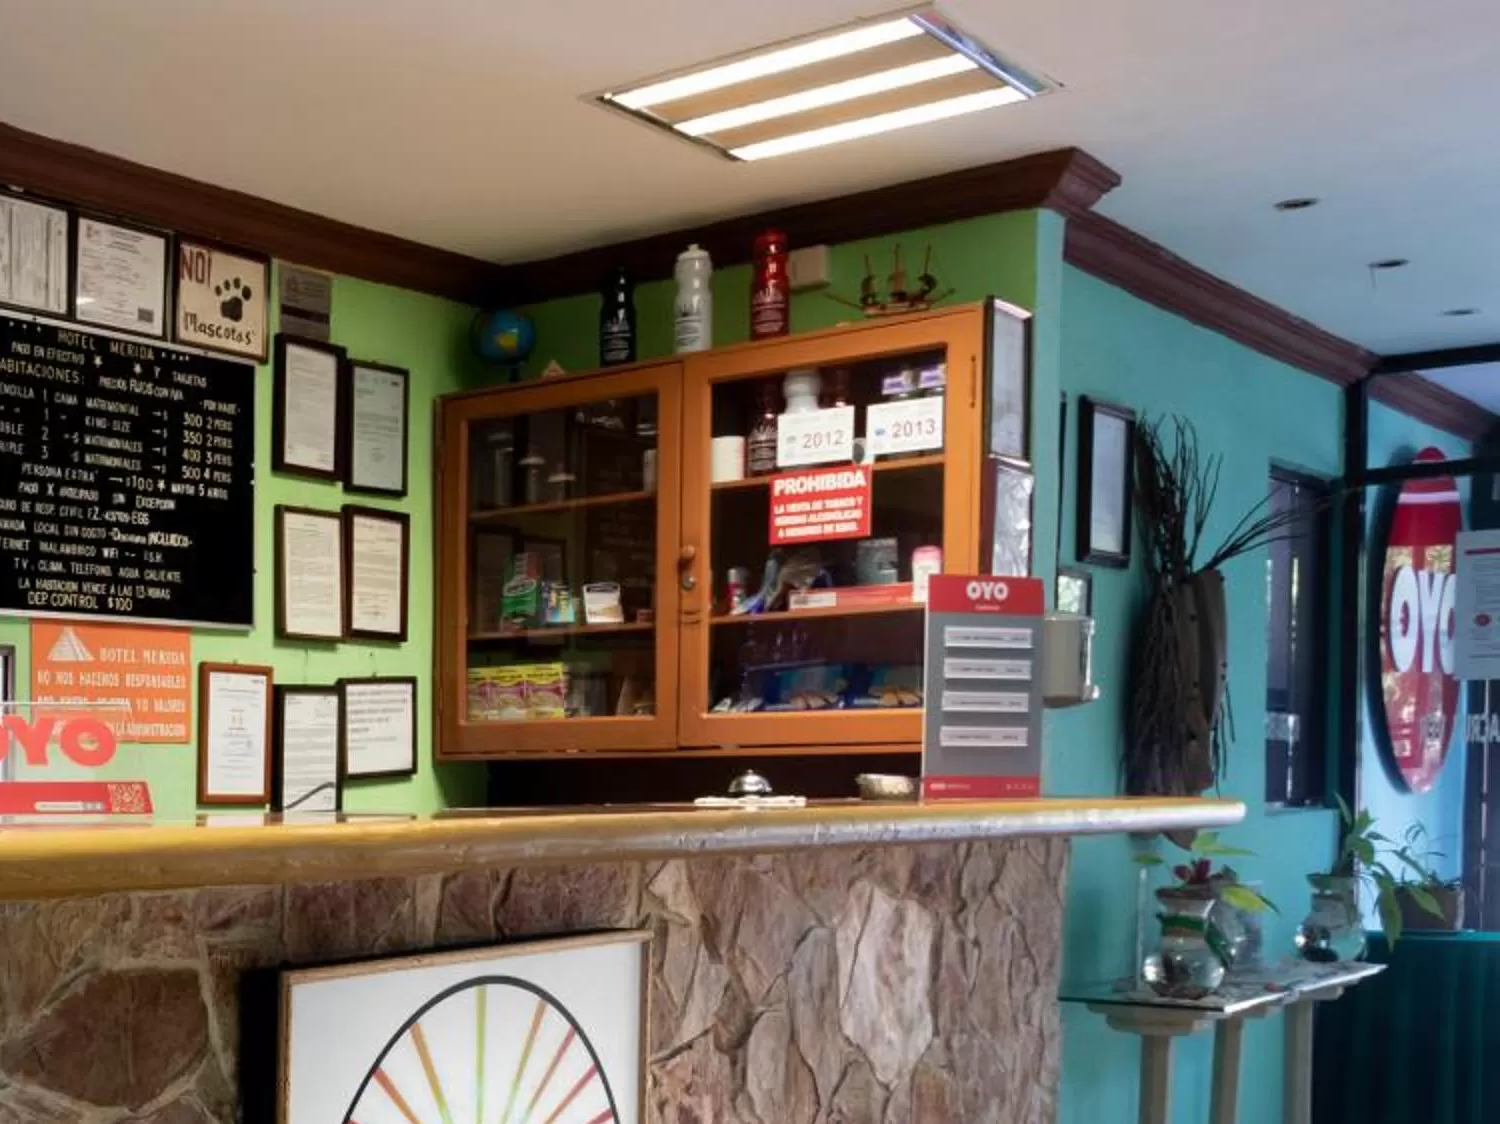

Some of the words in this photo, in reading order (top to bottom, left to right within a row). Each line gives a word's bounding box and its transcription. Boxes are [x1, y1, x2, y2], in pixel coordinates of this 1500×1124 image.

[58, 329, 96, 351] HOTEL
[110, 340, 155, 360] MERIDA
[41, 425, 49, 441] 2
[182, 429, 203, 445] 350
[891, 418, 937, 439] 2013
[802, 429, 845, 449] 2012
[182, 465, 201, 480] 500
[773, 469, 867, 497] PROHIBIDA
[965, 580, 1010, 601] OYO
